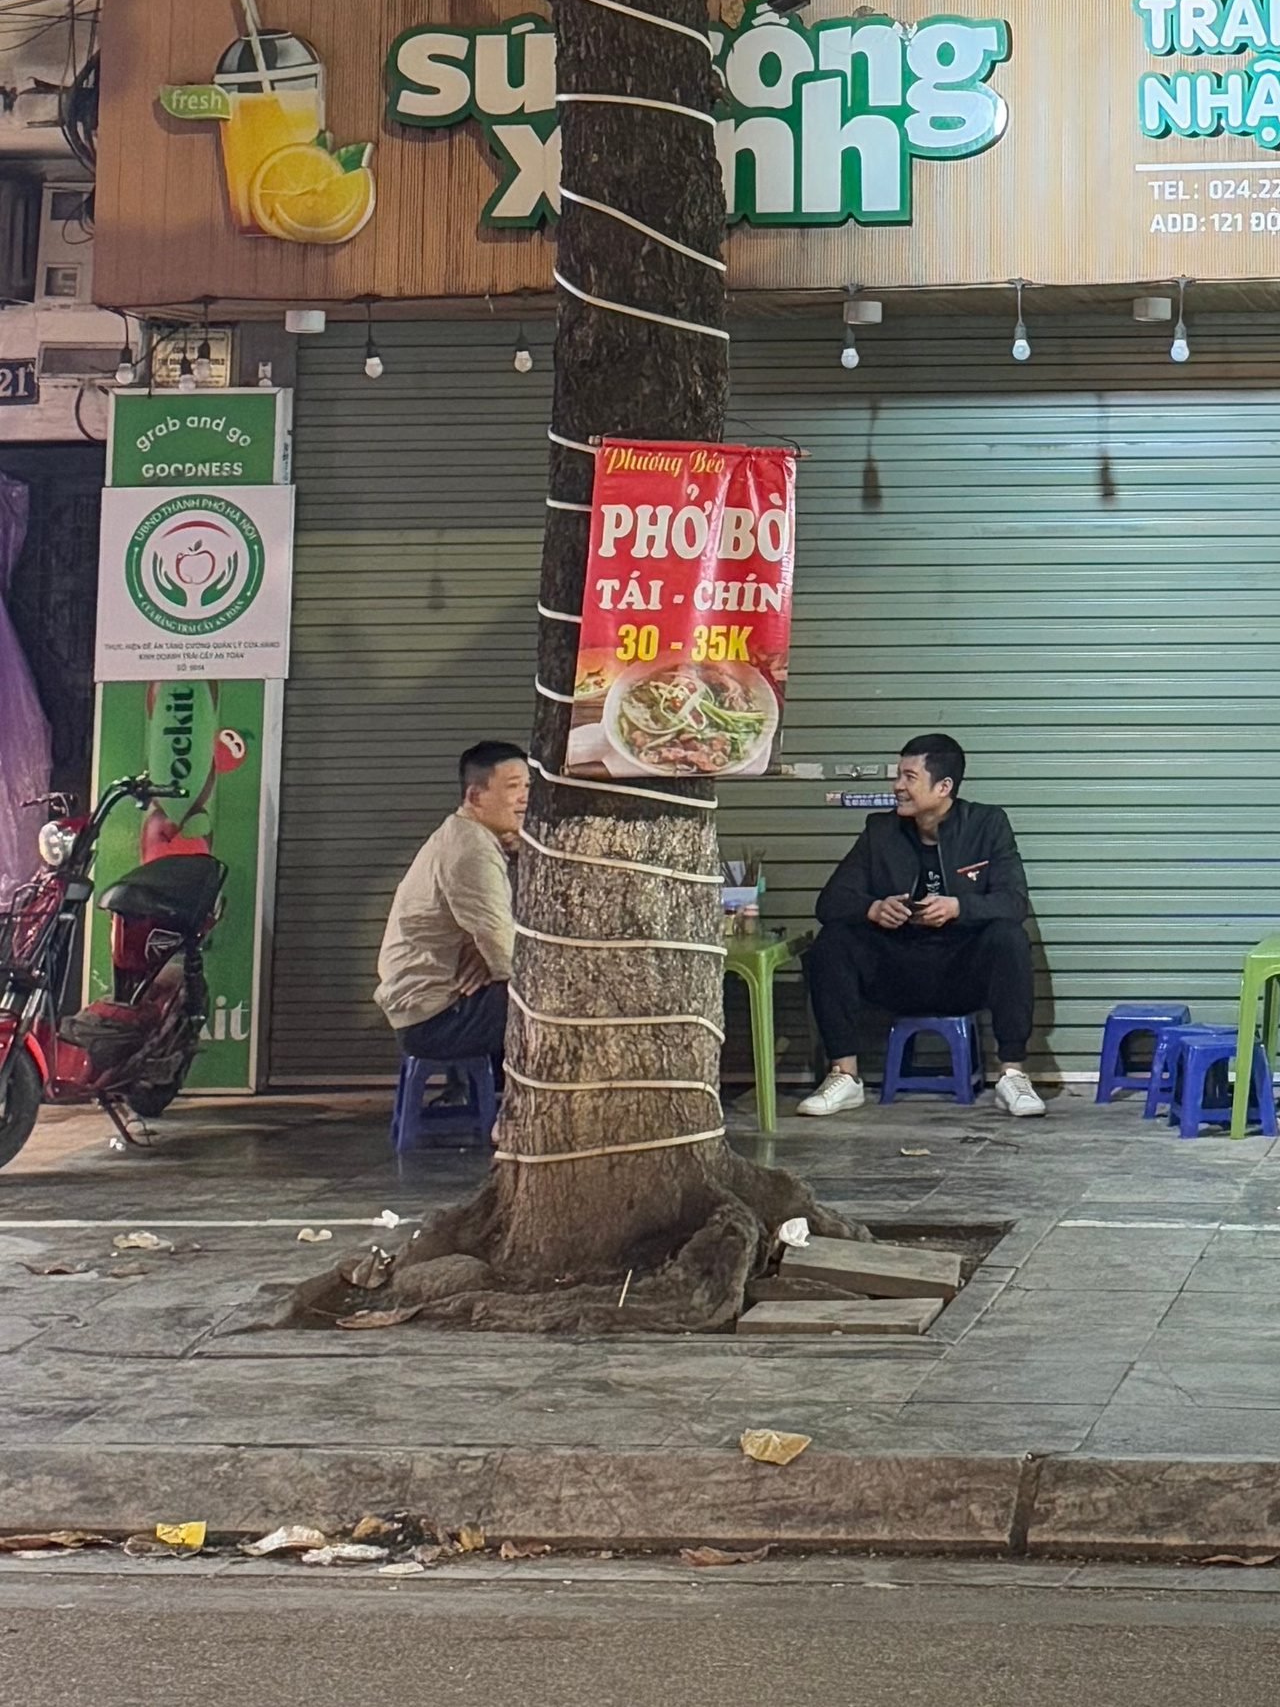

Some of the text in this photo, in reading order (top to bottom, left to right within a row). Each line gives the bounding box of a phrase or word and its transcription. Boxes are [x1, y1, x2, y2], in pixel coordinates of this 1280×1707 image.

[171, 89, 222, 110] fresh
[490, 76, 901, 218] xnh
[1210, 212, 1243, 233] 121
[136, 416, 251, 452] grab and go
[141, 461, 243, 478] GOODNESS
[598, 483, 789, 563] PHỞ BÒ
[596, 570, 665, 612] TÁI
[693, 573, 784, 613] CHÍN
[616, 624, 660, 662] 30
[691, 625, 754, 662] 35K
